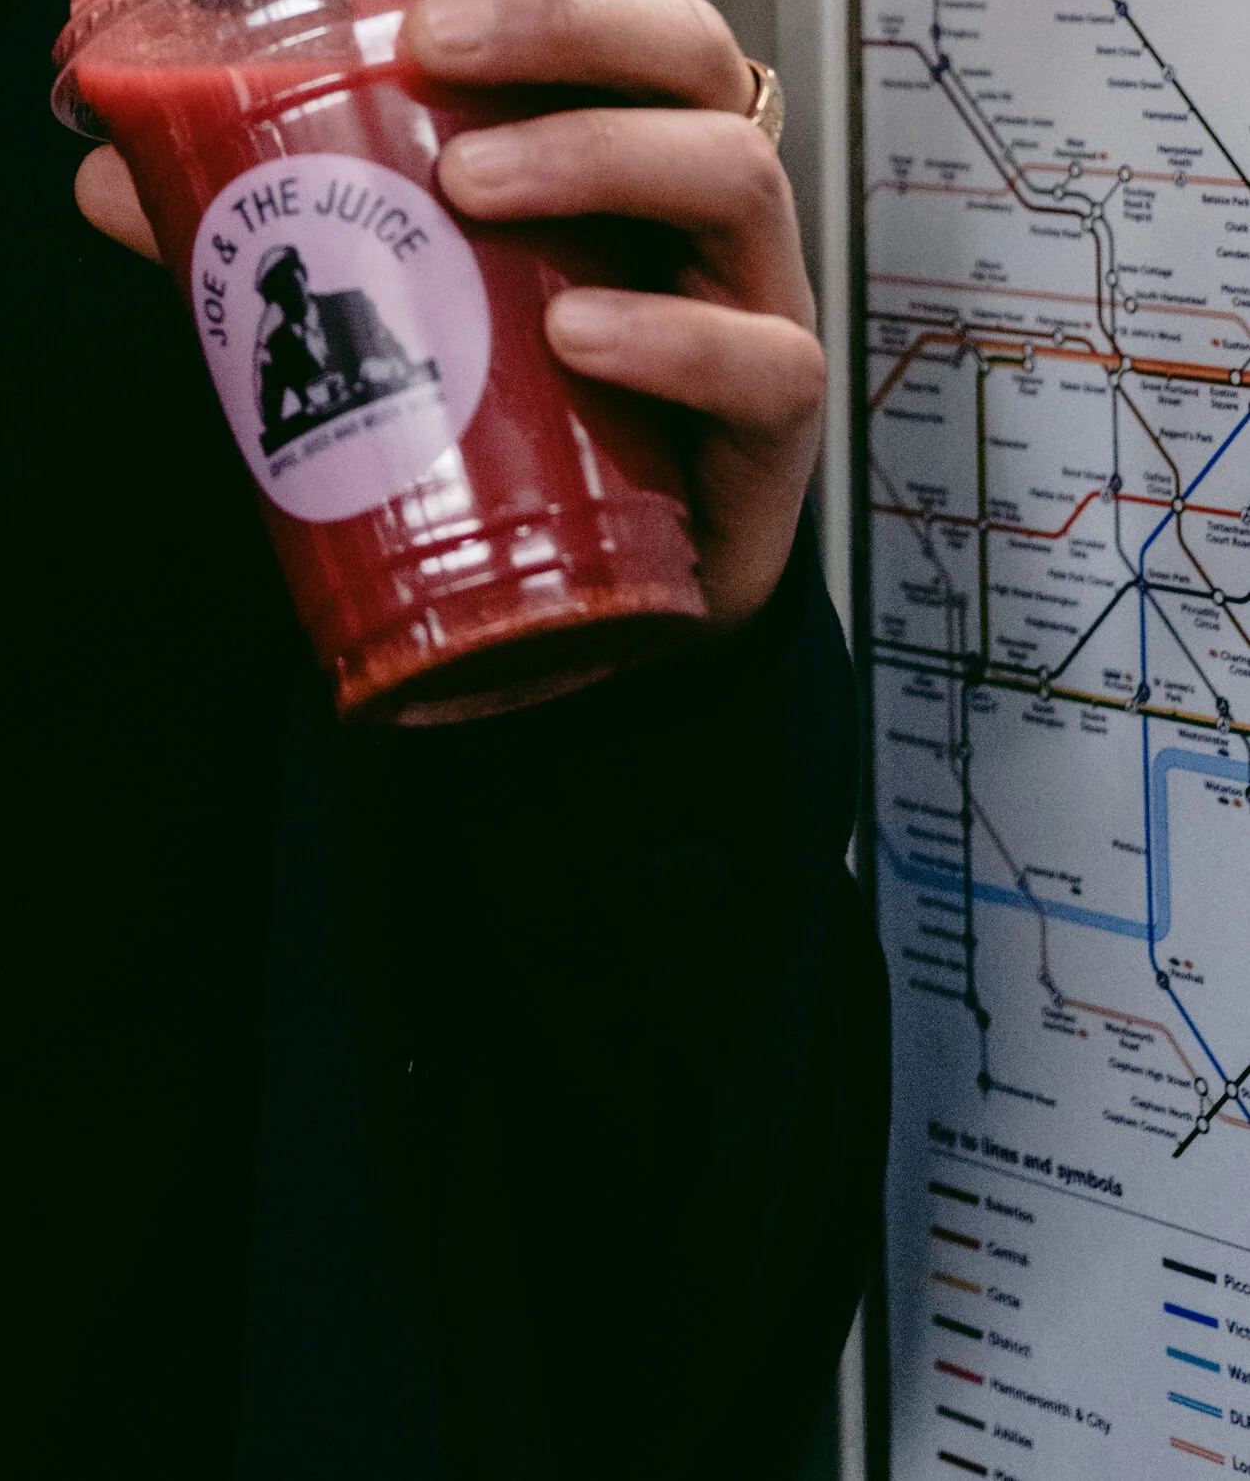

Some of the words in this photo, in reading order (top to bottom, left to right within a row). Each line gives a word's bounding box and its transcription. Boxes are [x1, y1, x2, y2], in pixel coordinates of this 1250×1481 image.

[232, 177, 301, 233] THE
[313, 179, 430, 263] JUICE
[213, 233, 238, 264] &
[203, 271, 228, 347] JOE
[981, 1136, 1019, 1165] lines
[1023, 1153, 1053, 1176] and
[1056, 1163, 1124, 1198] symbols
